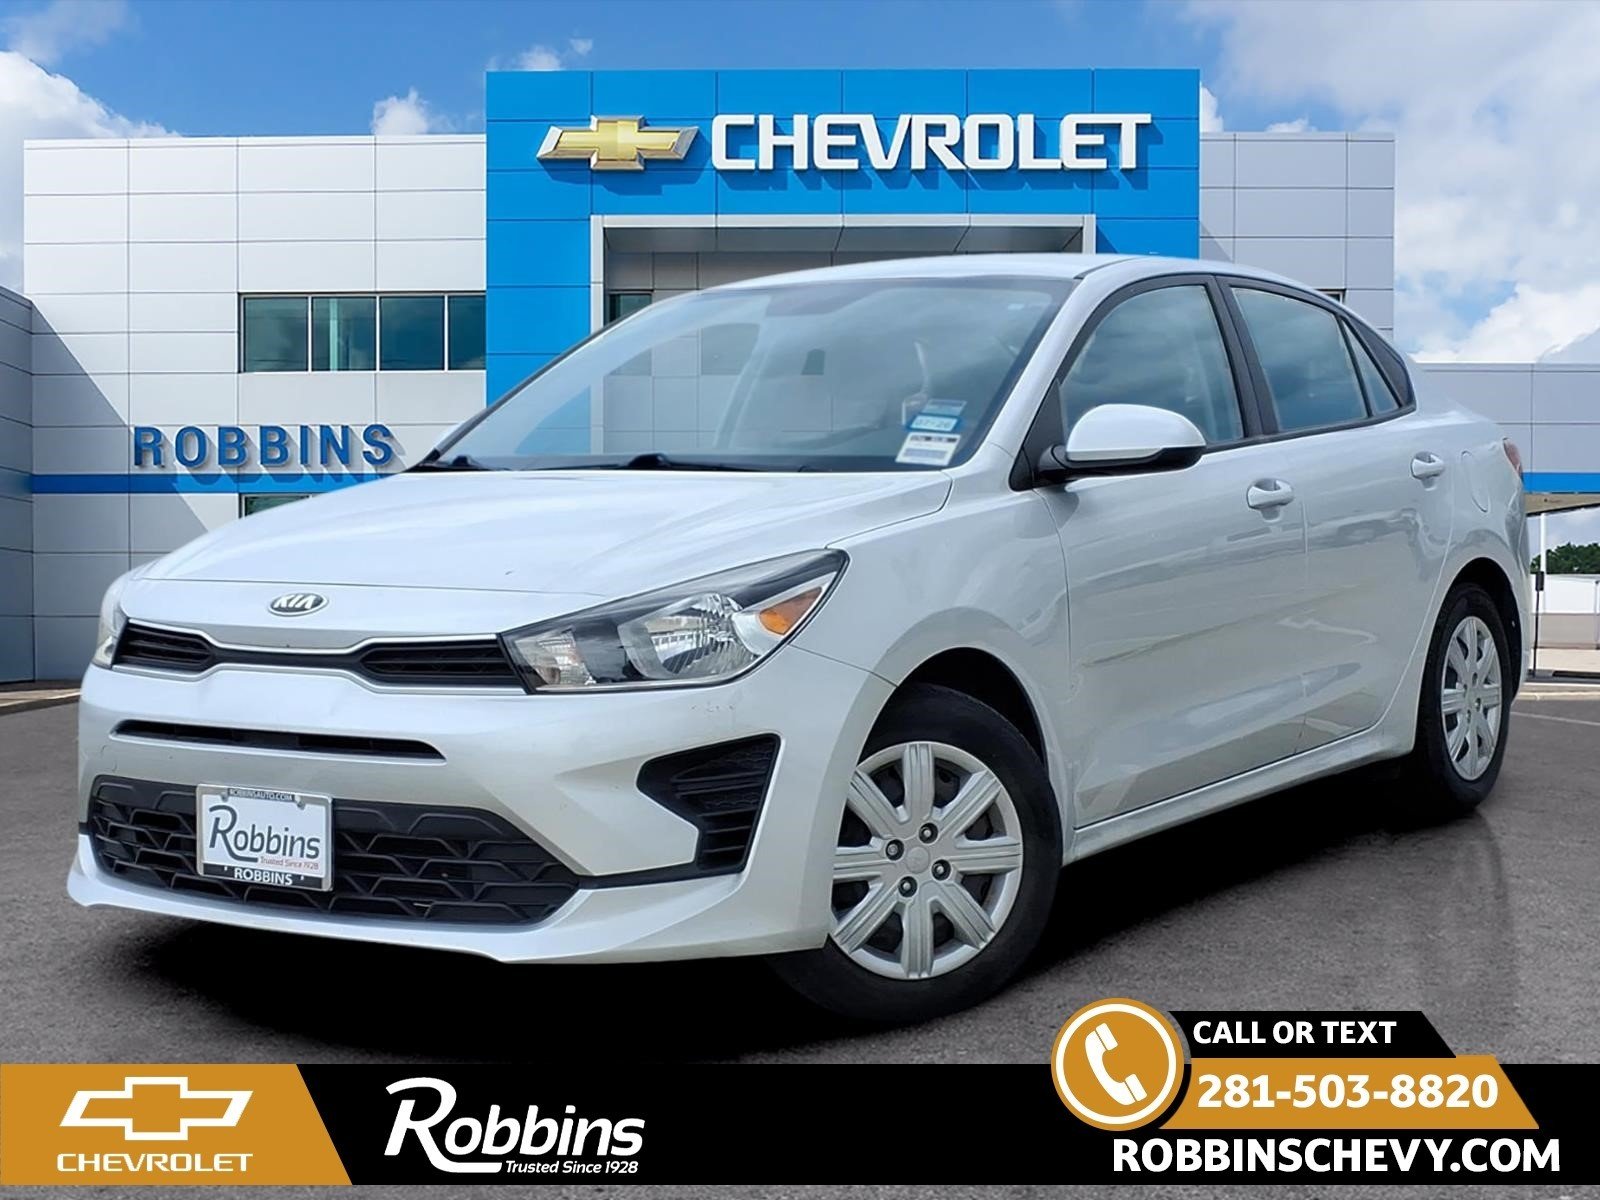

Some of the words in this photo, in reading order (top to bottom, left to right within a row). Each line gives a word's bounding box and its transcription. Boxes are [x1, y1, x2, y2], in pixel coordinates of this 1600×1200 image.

[711, 113, 1152, 171] CHEVROLET
[133, 423, 394, 468] ROBBINS
[272, 594, 317, 610] KIA
[209, 804, 321, 863] Robbins
[233, 867, 293, 886] ROBBINS
